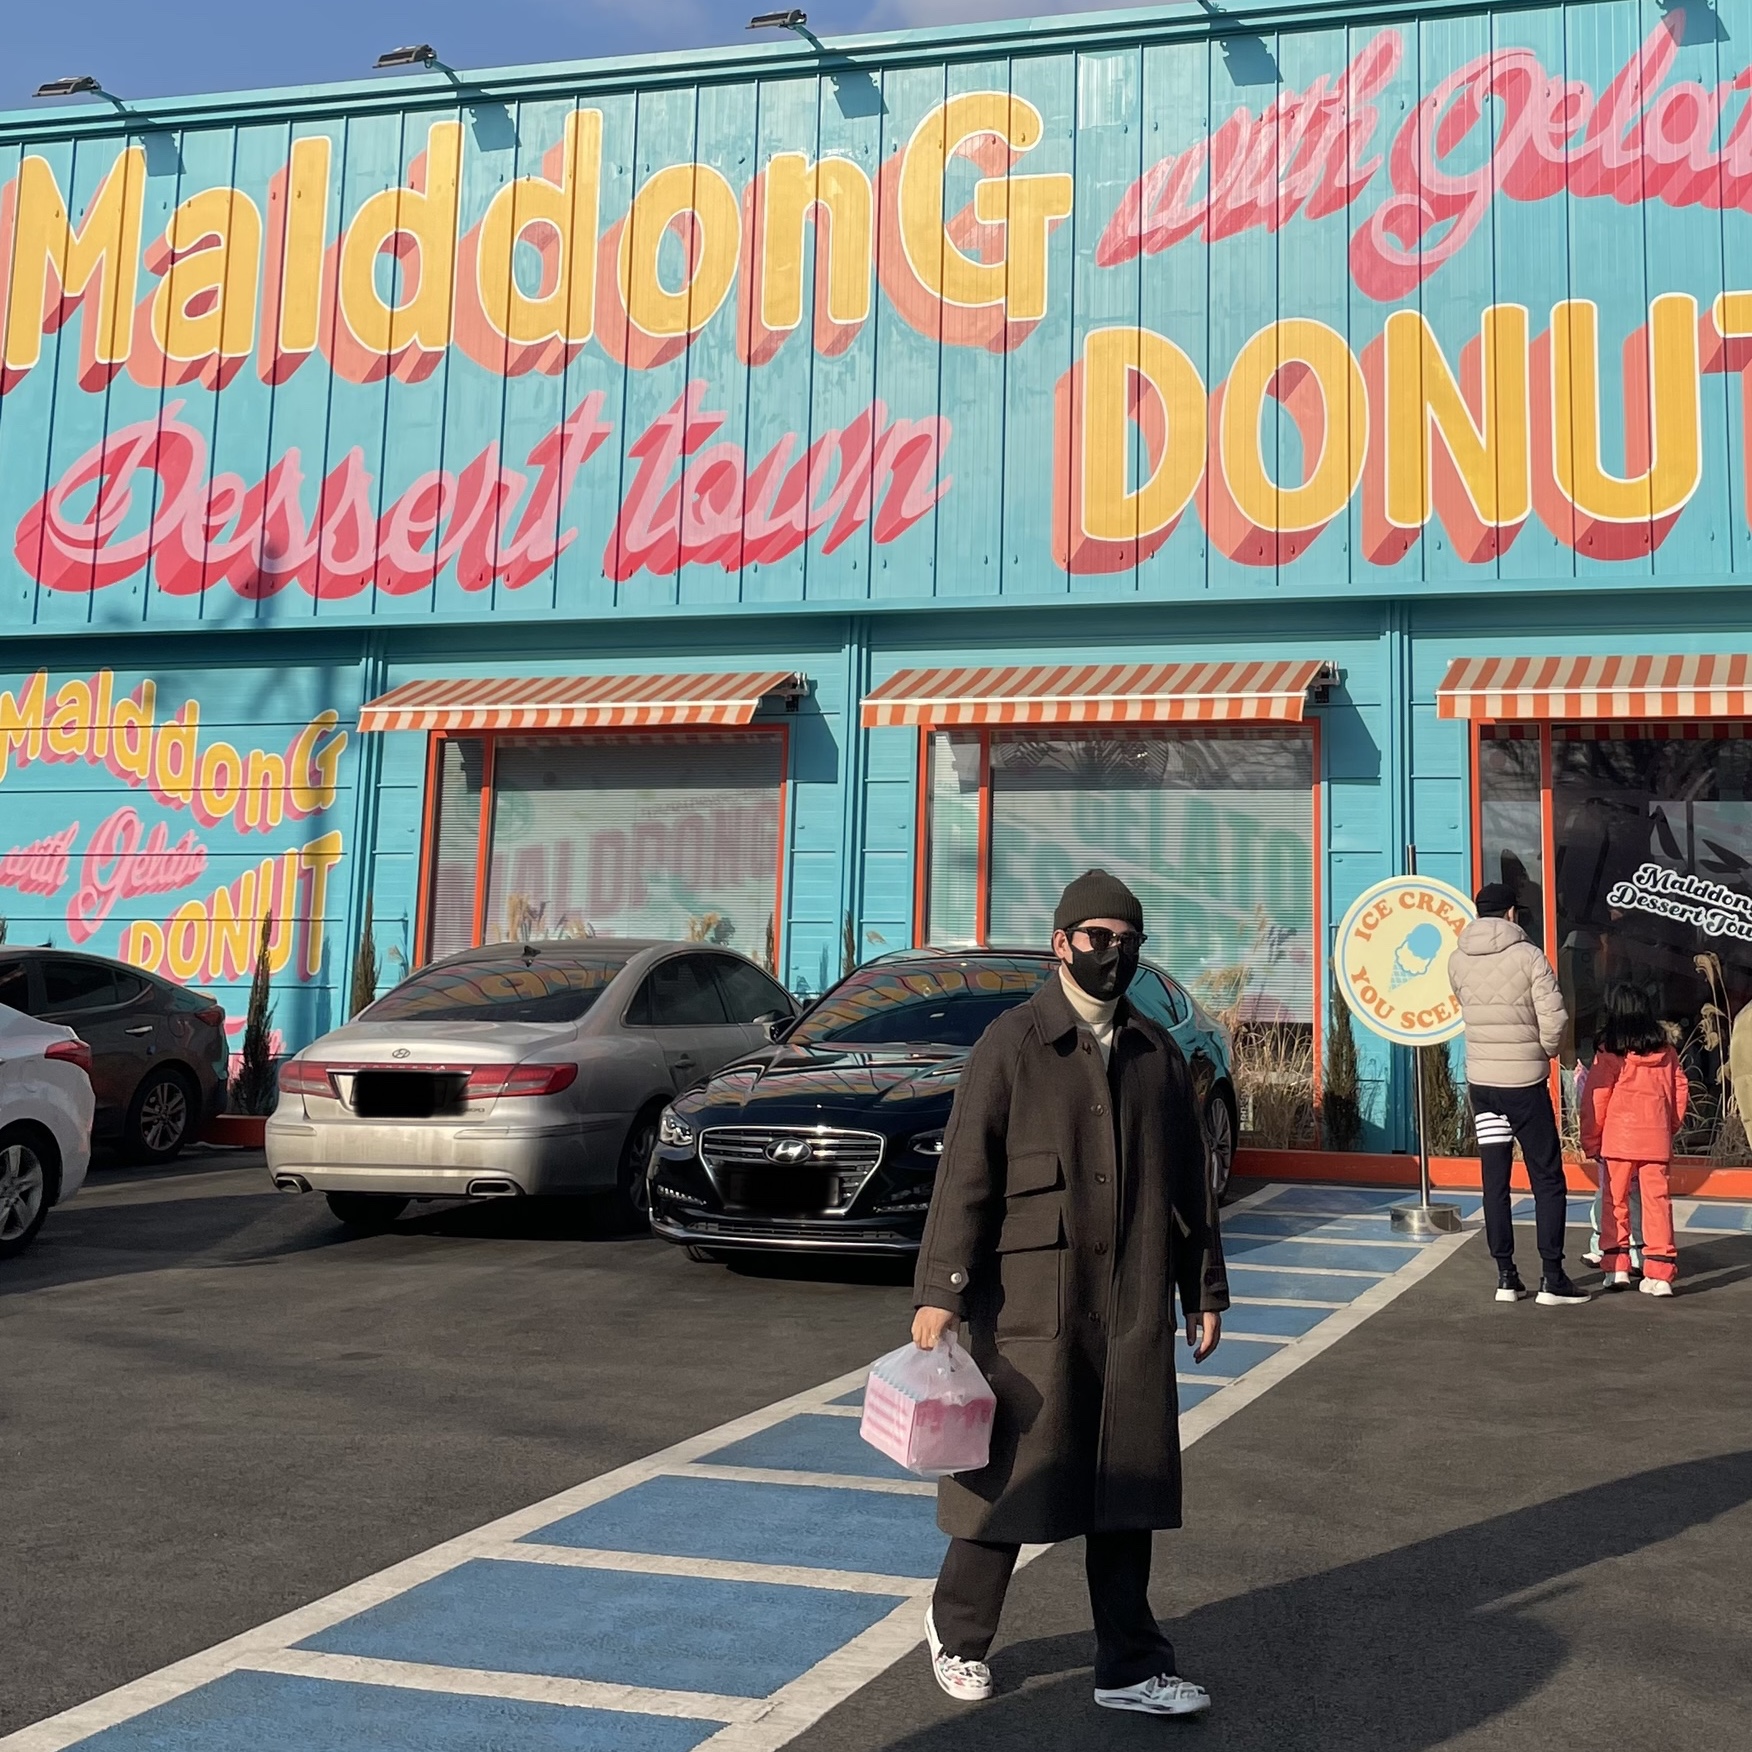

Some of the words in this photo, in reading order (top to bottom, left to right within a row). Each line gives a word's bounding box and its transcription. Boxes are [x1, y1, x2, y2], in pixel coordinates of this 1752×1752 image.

[44, 392, 614, 578] Dessert
[620, 379, 954, 556] town
[127, 829, 342, 979] DONUT
[1608, 883, 1706, 925] Dessert
[1634, 863, 1752, 918] Malddon
[1354, 898, 1393, 942] ICE
[1351, 965, 1395, 1019] YOU
